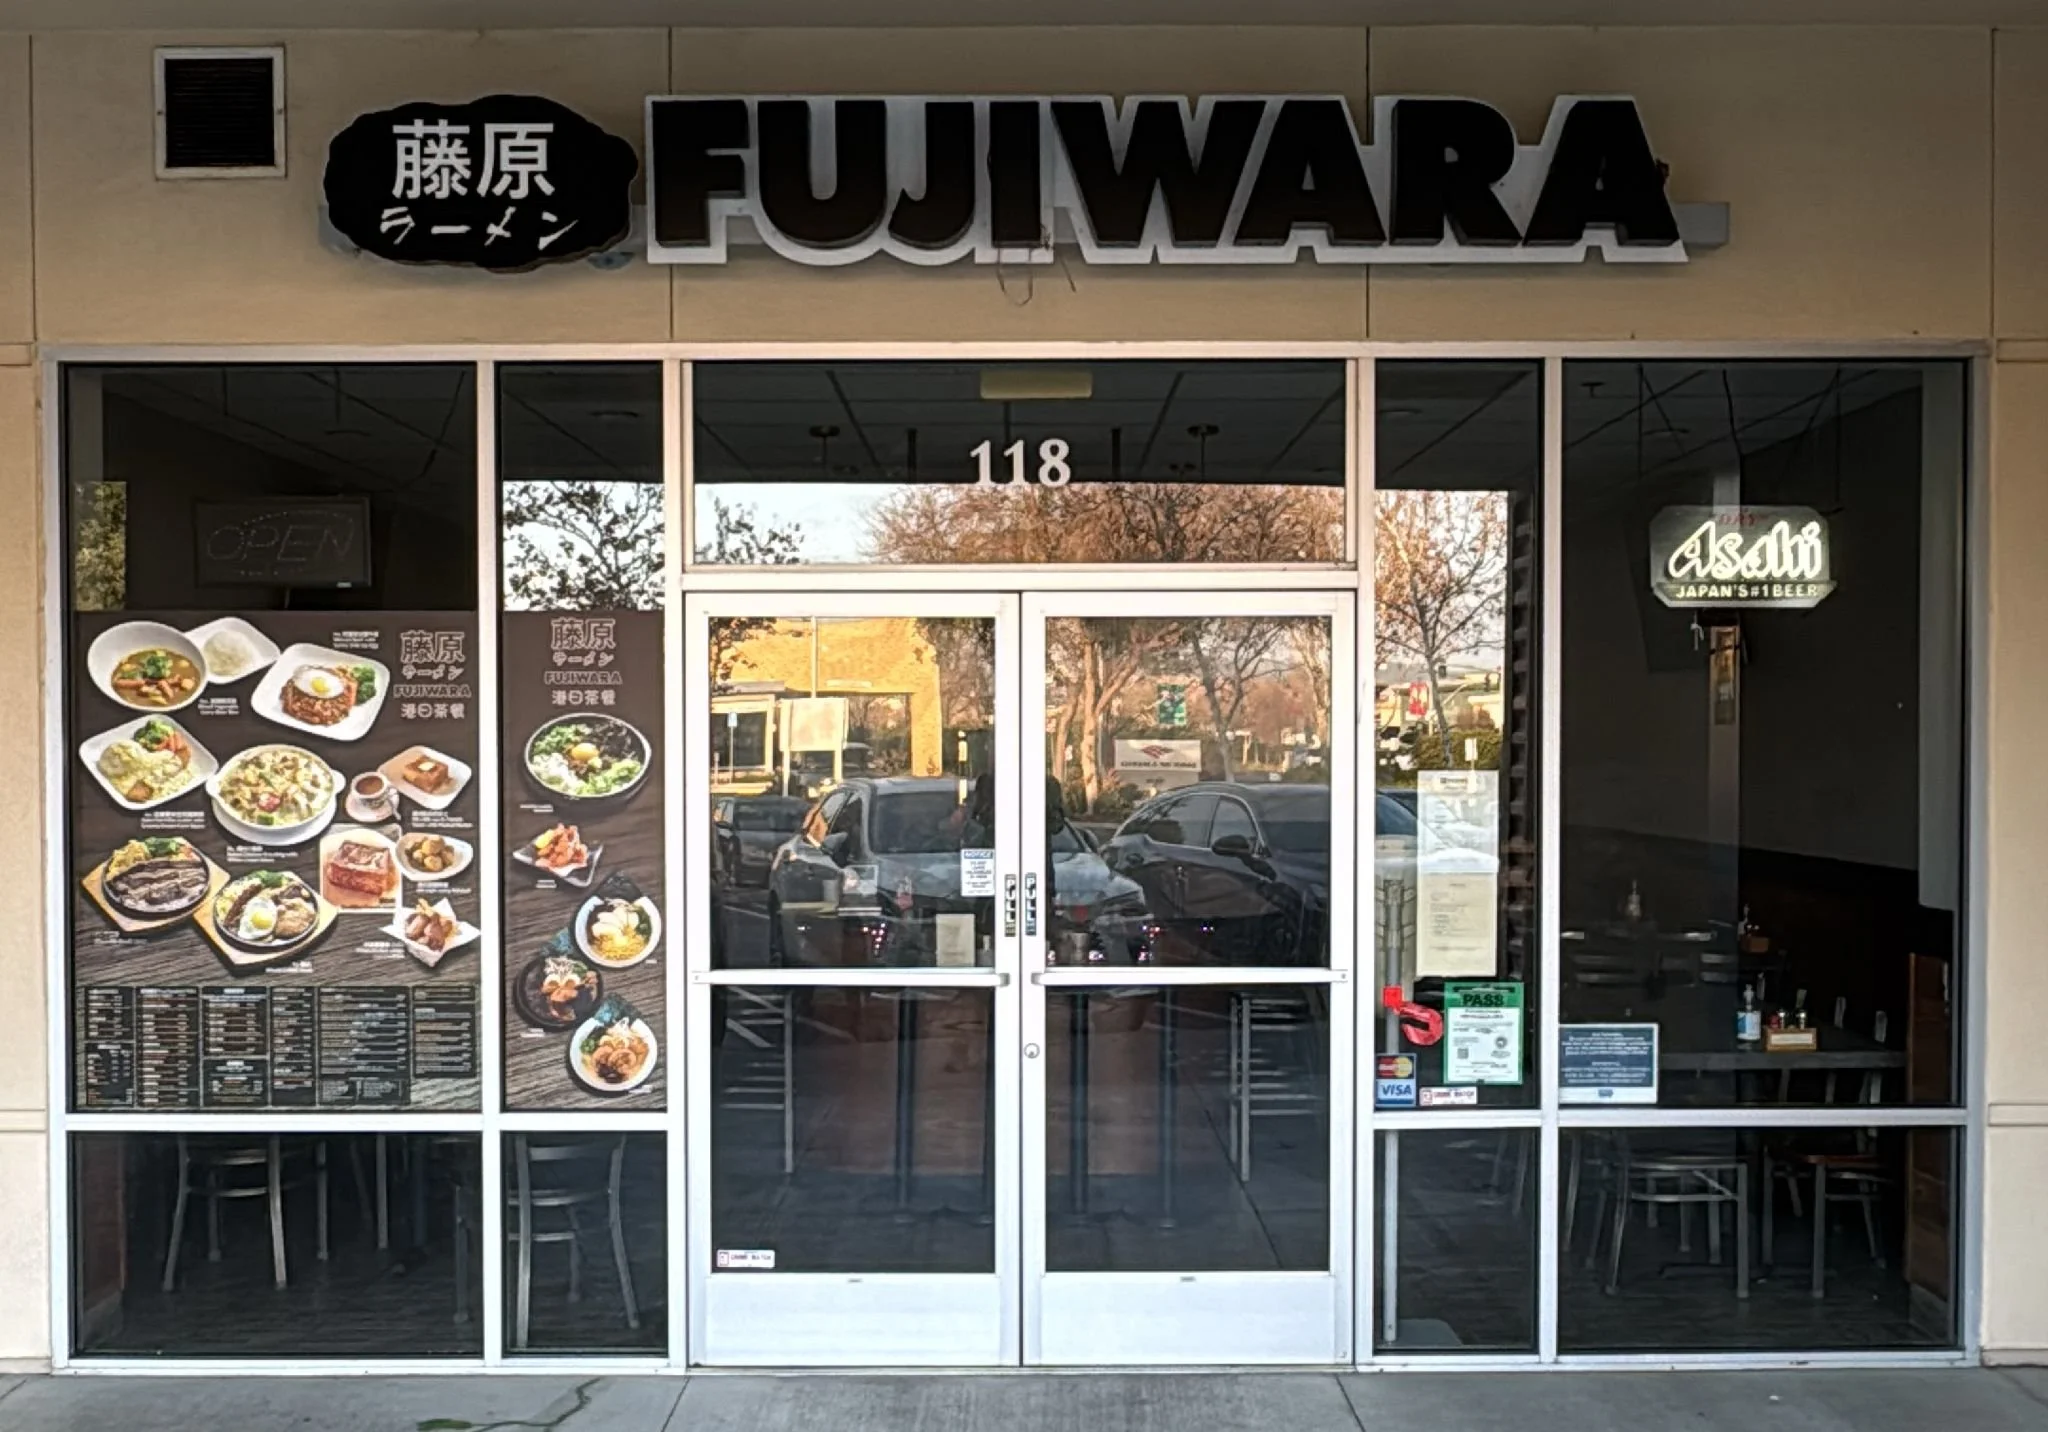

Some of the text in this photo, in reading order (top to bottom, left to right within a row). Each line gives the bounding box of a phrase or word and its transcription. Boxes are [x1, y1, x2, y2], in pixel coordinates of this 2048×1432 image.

[392, 118, 556, 200] 藤原
[648, 98, 1684, 250] FUJIWARA
[379, 206, 580, 251] ラーメン
[969, 437, 1072, 488] 118
[206, 521, 356, 562] OPEN
[1667, 520, 1823, 580] Asahi
[1675, 583, 1748, 599] JAPAN'S
[1772, 583, 1818, 598] BEER
[399, 629, 466, 663] 藤原
[549, 616, 617, 651] 藤原
[392, 683, 472, 699] FUJIWARA
[543, 670, 623, 686] FUJIWARA
[1005, 879, 1016, 923] PULL
[1026, 876, 1037, 921] PULL
[1462, 993, 1505, 1007] PASS
[1382, 1084, 1412, 1096] VISA
